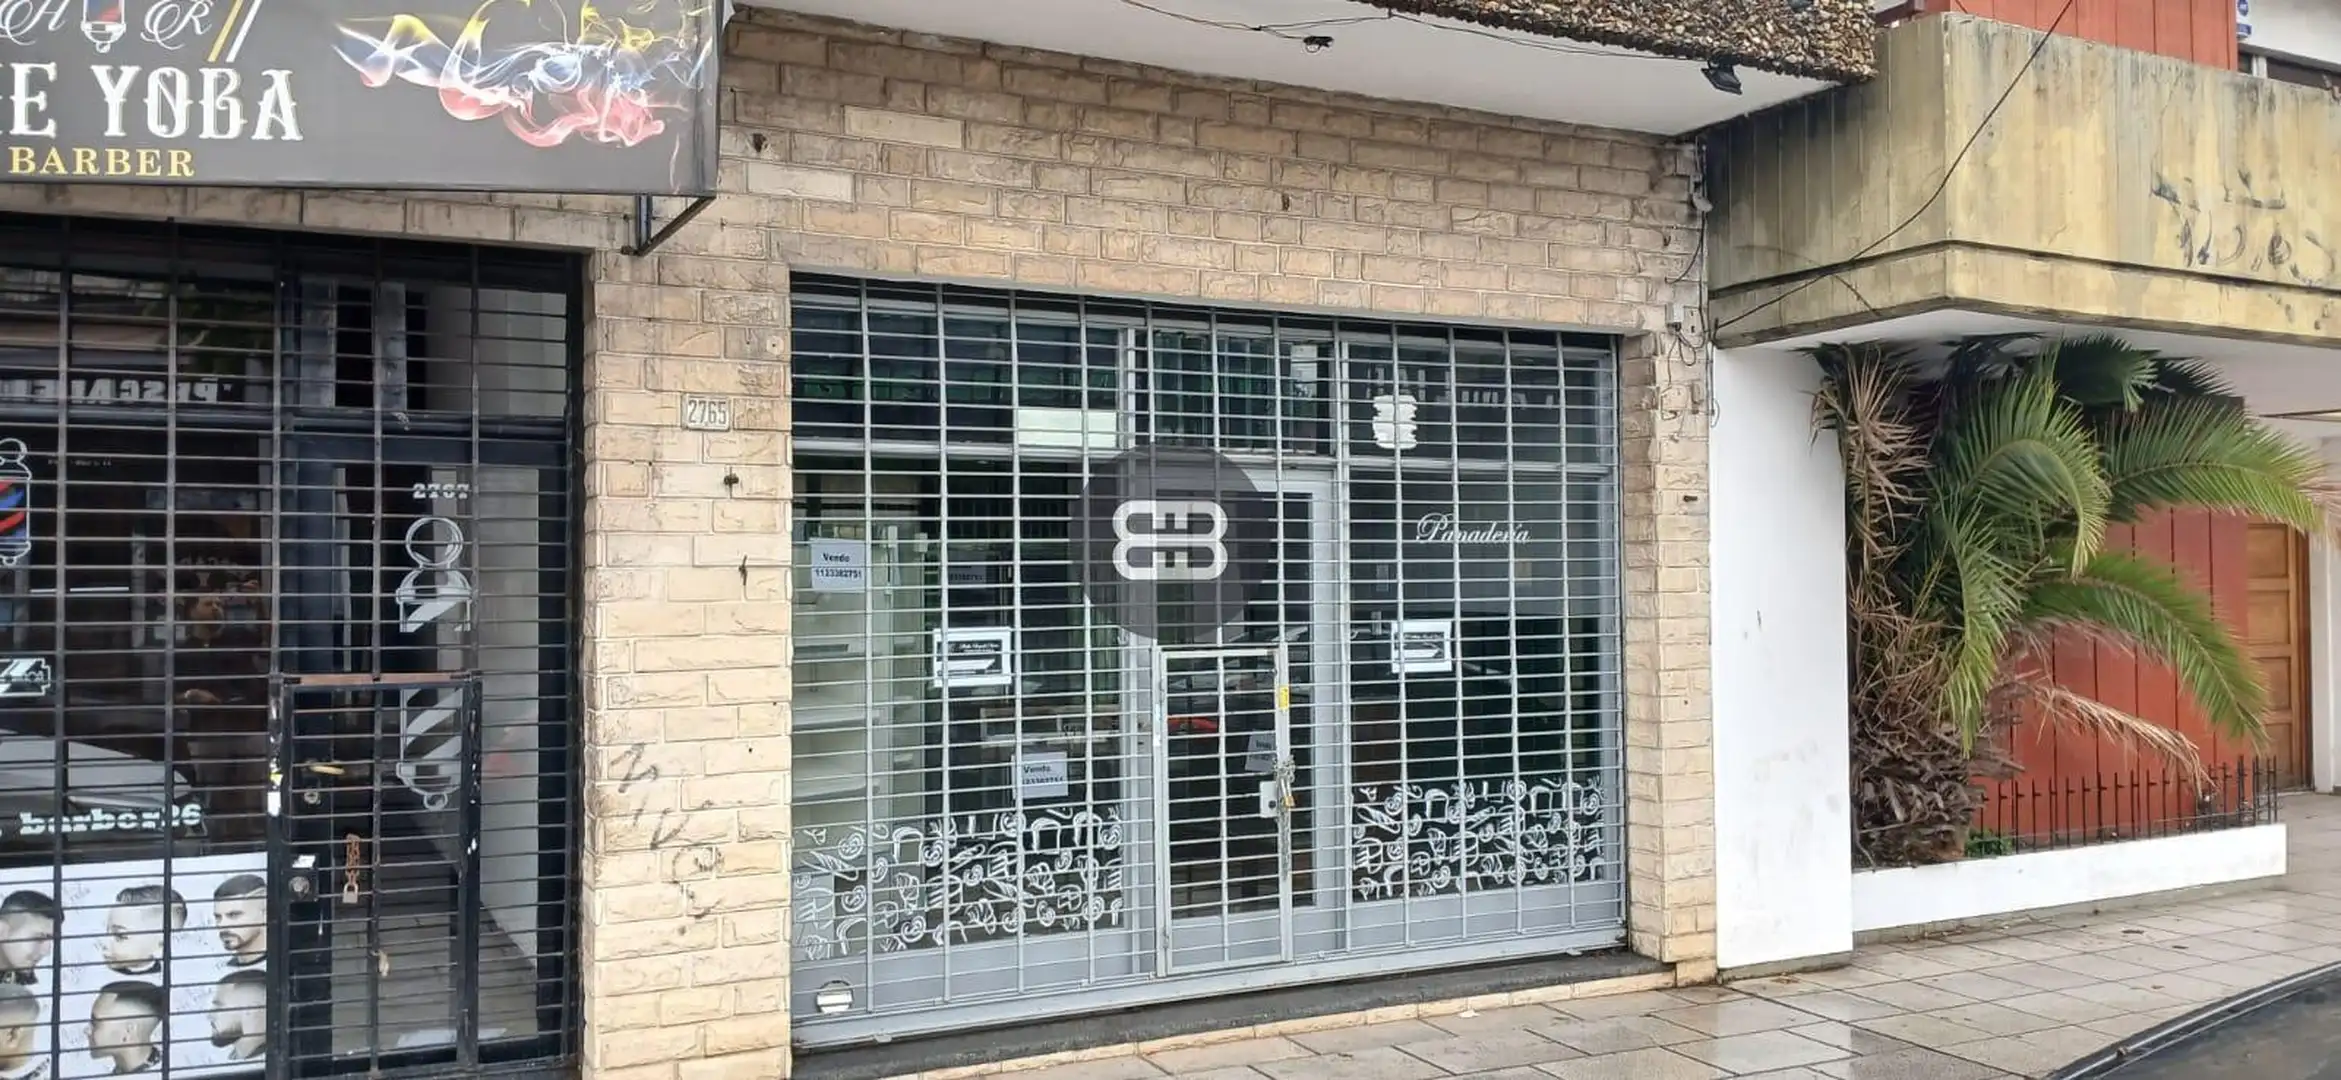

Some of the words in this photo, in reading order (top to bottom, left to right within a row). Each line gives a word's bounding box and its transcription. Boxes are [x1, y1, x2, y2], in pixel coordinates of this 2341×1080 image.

[90, 64, 304, 141] YOBA
[8, 146, 195, 177] BARBER
[688, 400, 727, 424] 2765
[1416, 512, 1531, 544] Panadería
